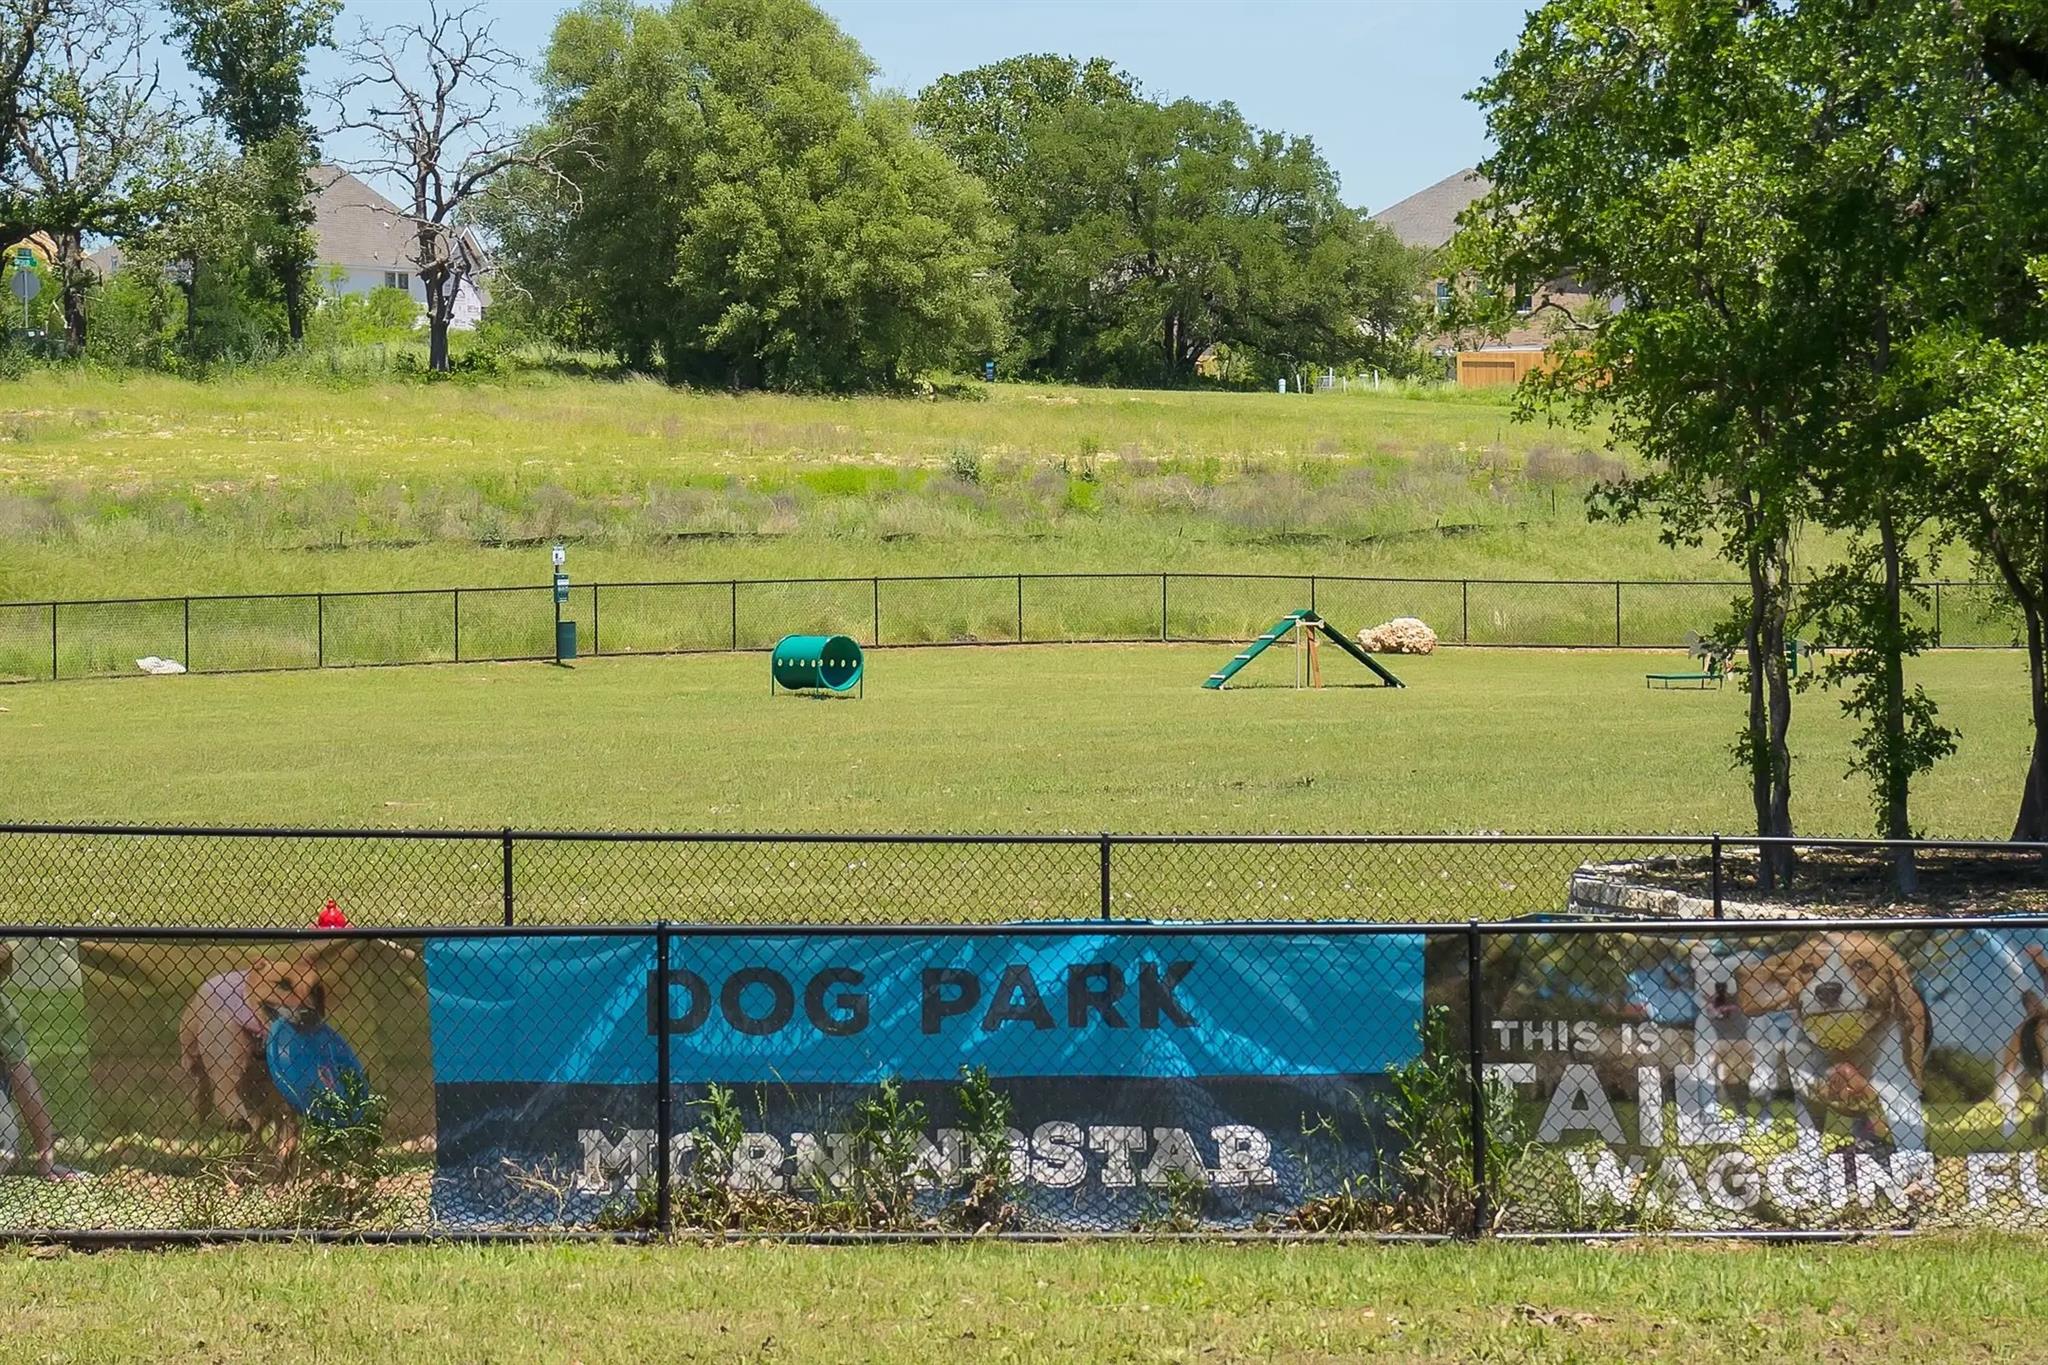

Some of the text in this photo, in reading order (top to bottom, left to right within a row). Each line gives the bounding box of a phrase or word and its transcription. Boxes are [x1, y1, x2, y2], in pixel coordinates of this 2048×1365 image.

[646, 961, 1197, 1037] DOG PARK
[1491, 1020, 1661, 1054] THIS IS
[1564, 1149, 1934, 1211] WAGGIN
